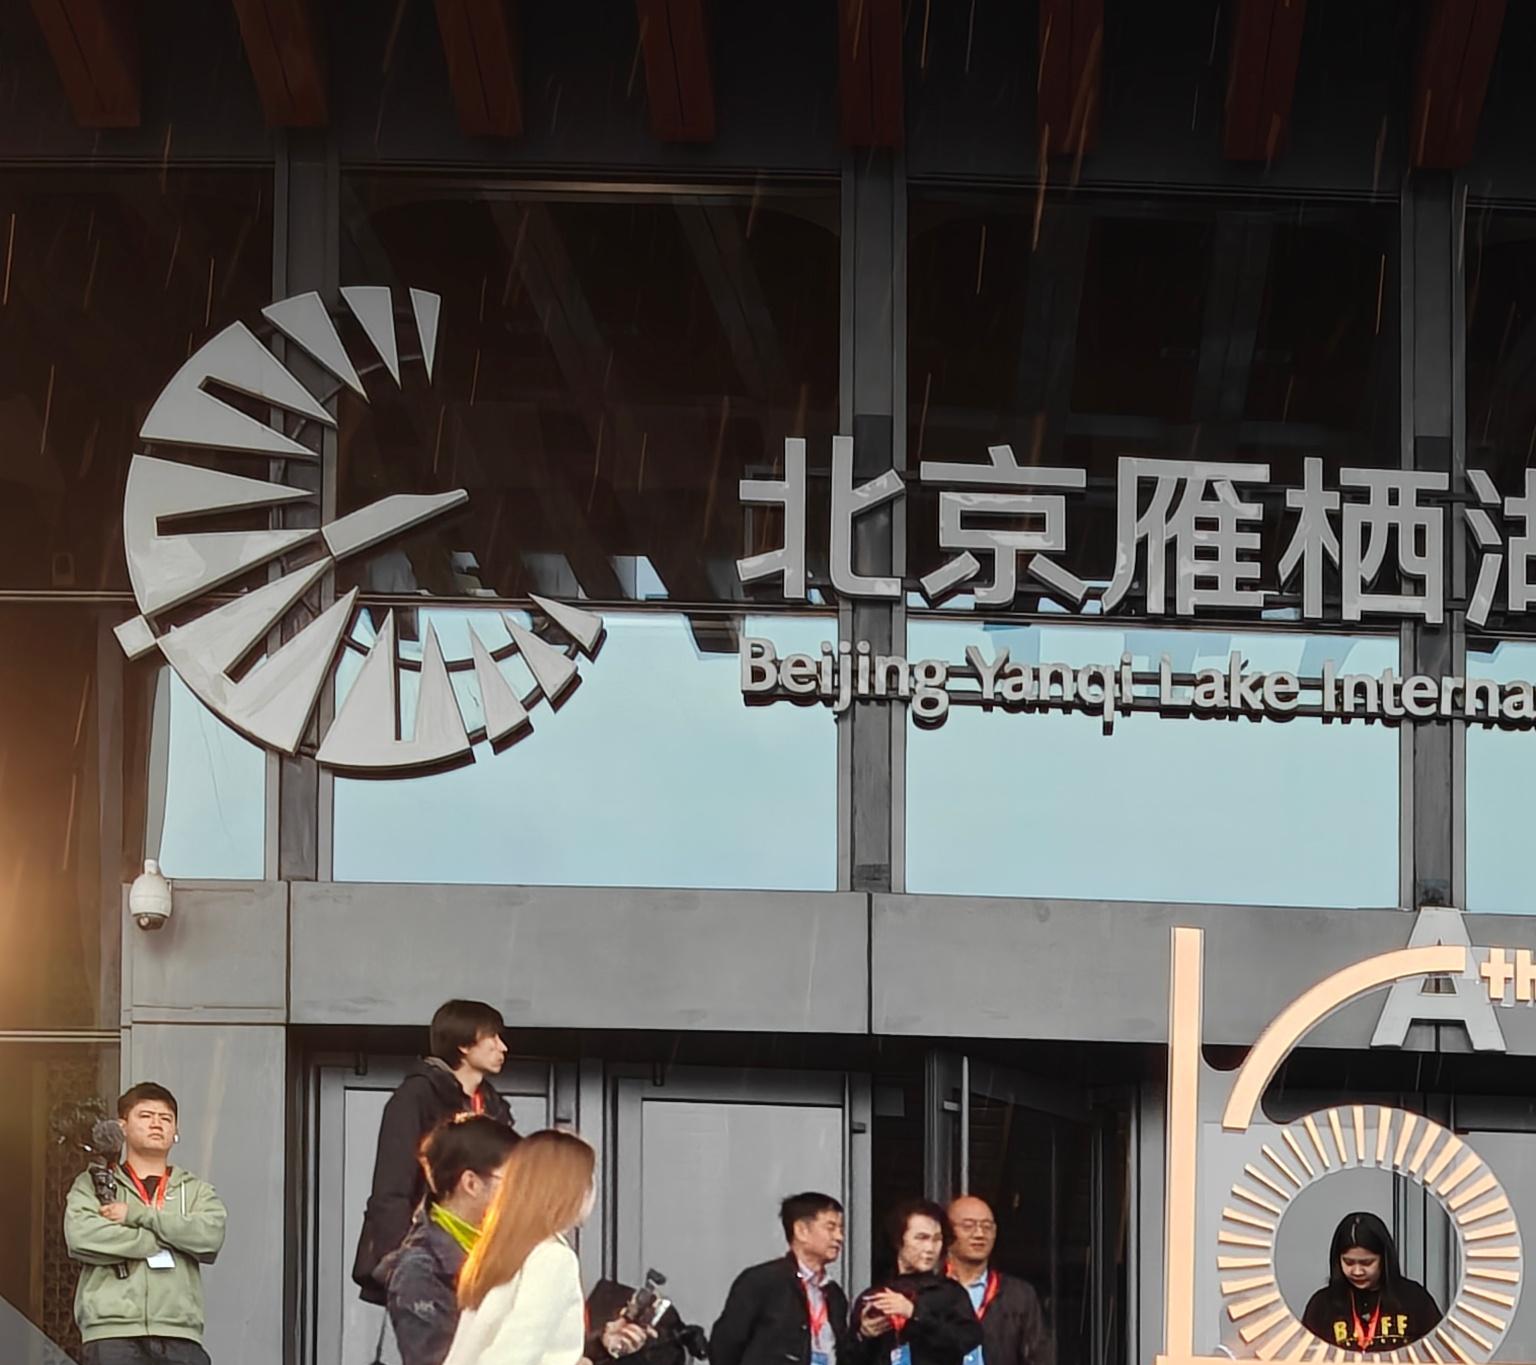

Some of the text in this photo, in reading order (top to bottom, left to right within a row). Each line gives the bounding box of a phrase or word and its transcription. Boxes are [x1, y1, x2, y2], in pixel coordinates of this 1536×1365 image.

[740, 637, 949, 718] Beijing
[965, 645, 1133, 723] Yanqi
[1159, 651, 1301, 711] Lake
[1371, 907, 1506, 1052] A
[1333, 1314, 1408, 1344] BFF
